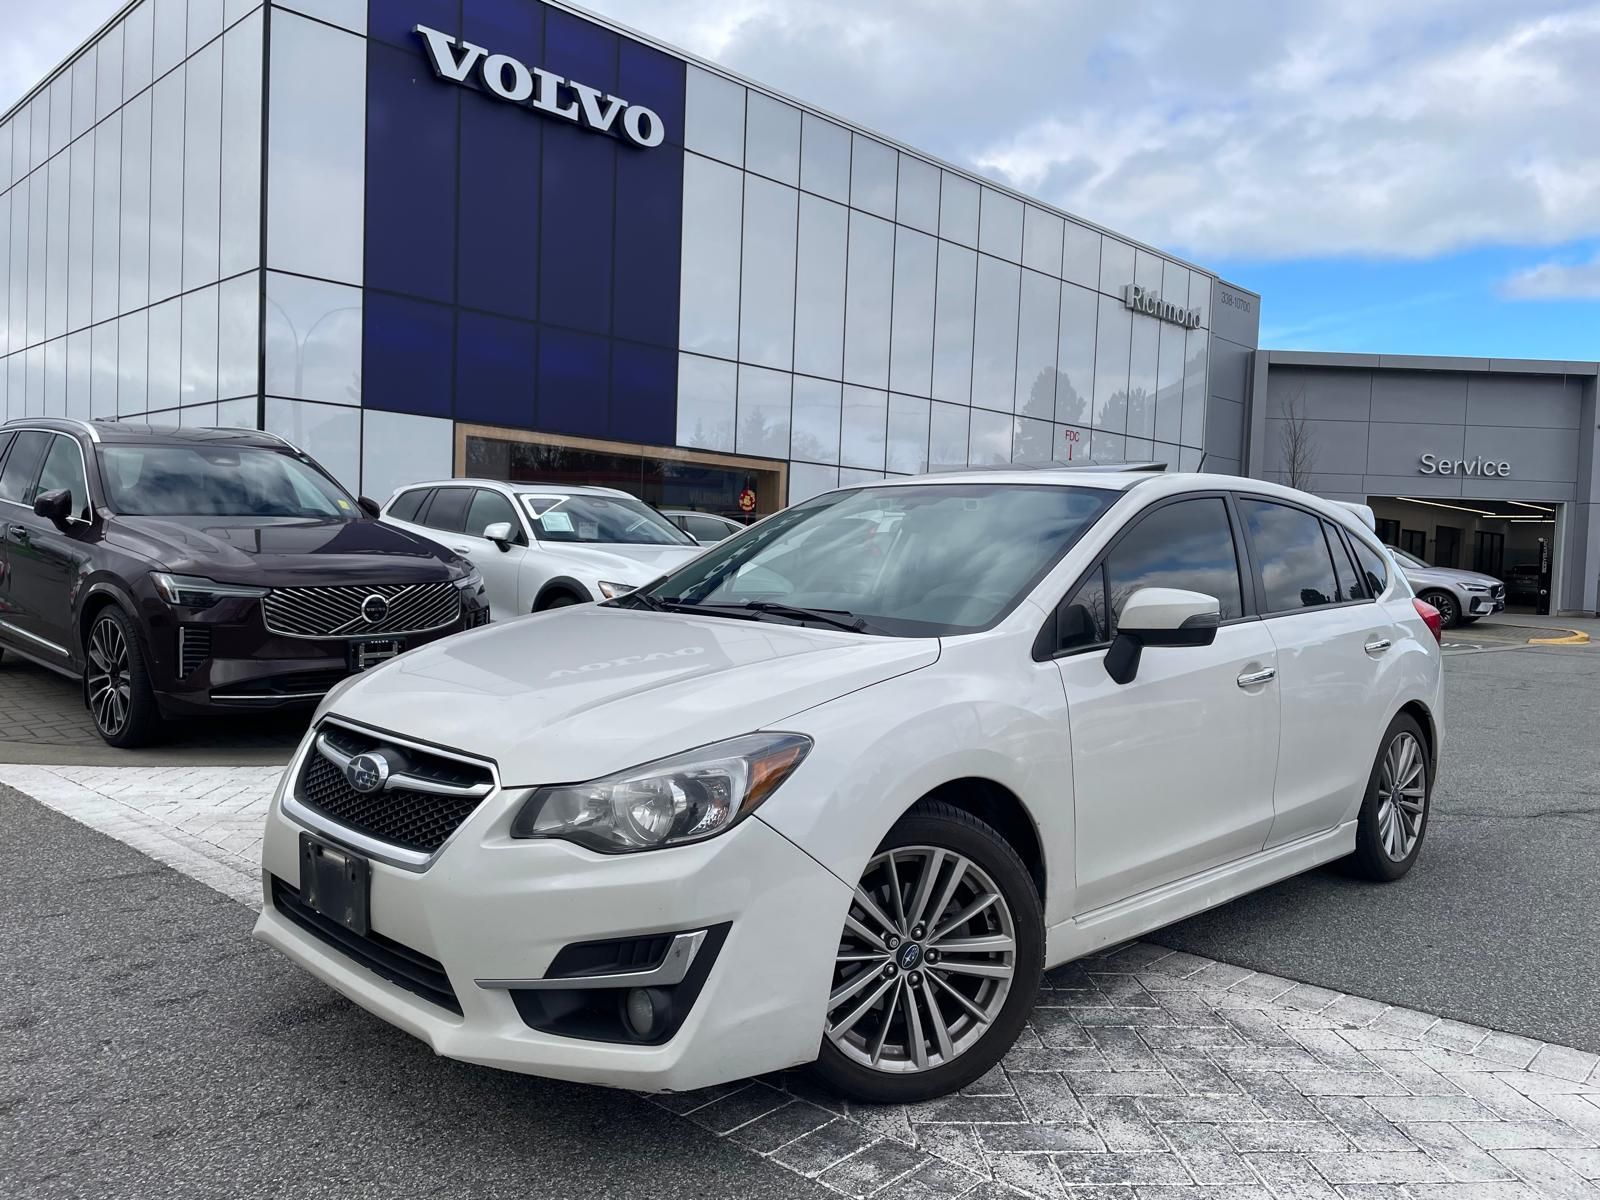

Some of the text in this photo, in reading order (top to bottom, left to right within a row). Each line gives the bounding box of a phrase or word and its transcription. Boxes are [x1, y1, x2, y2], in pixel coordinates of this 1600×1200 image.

[415, 23, 665, 148] VOLVO
[1128, 283, 1201, 329] Richmond
[1065, 429, 1080, 442] FDC
[1420, 453, 1511, 477] Service
